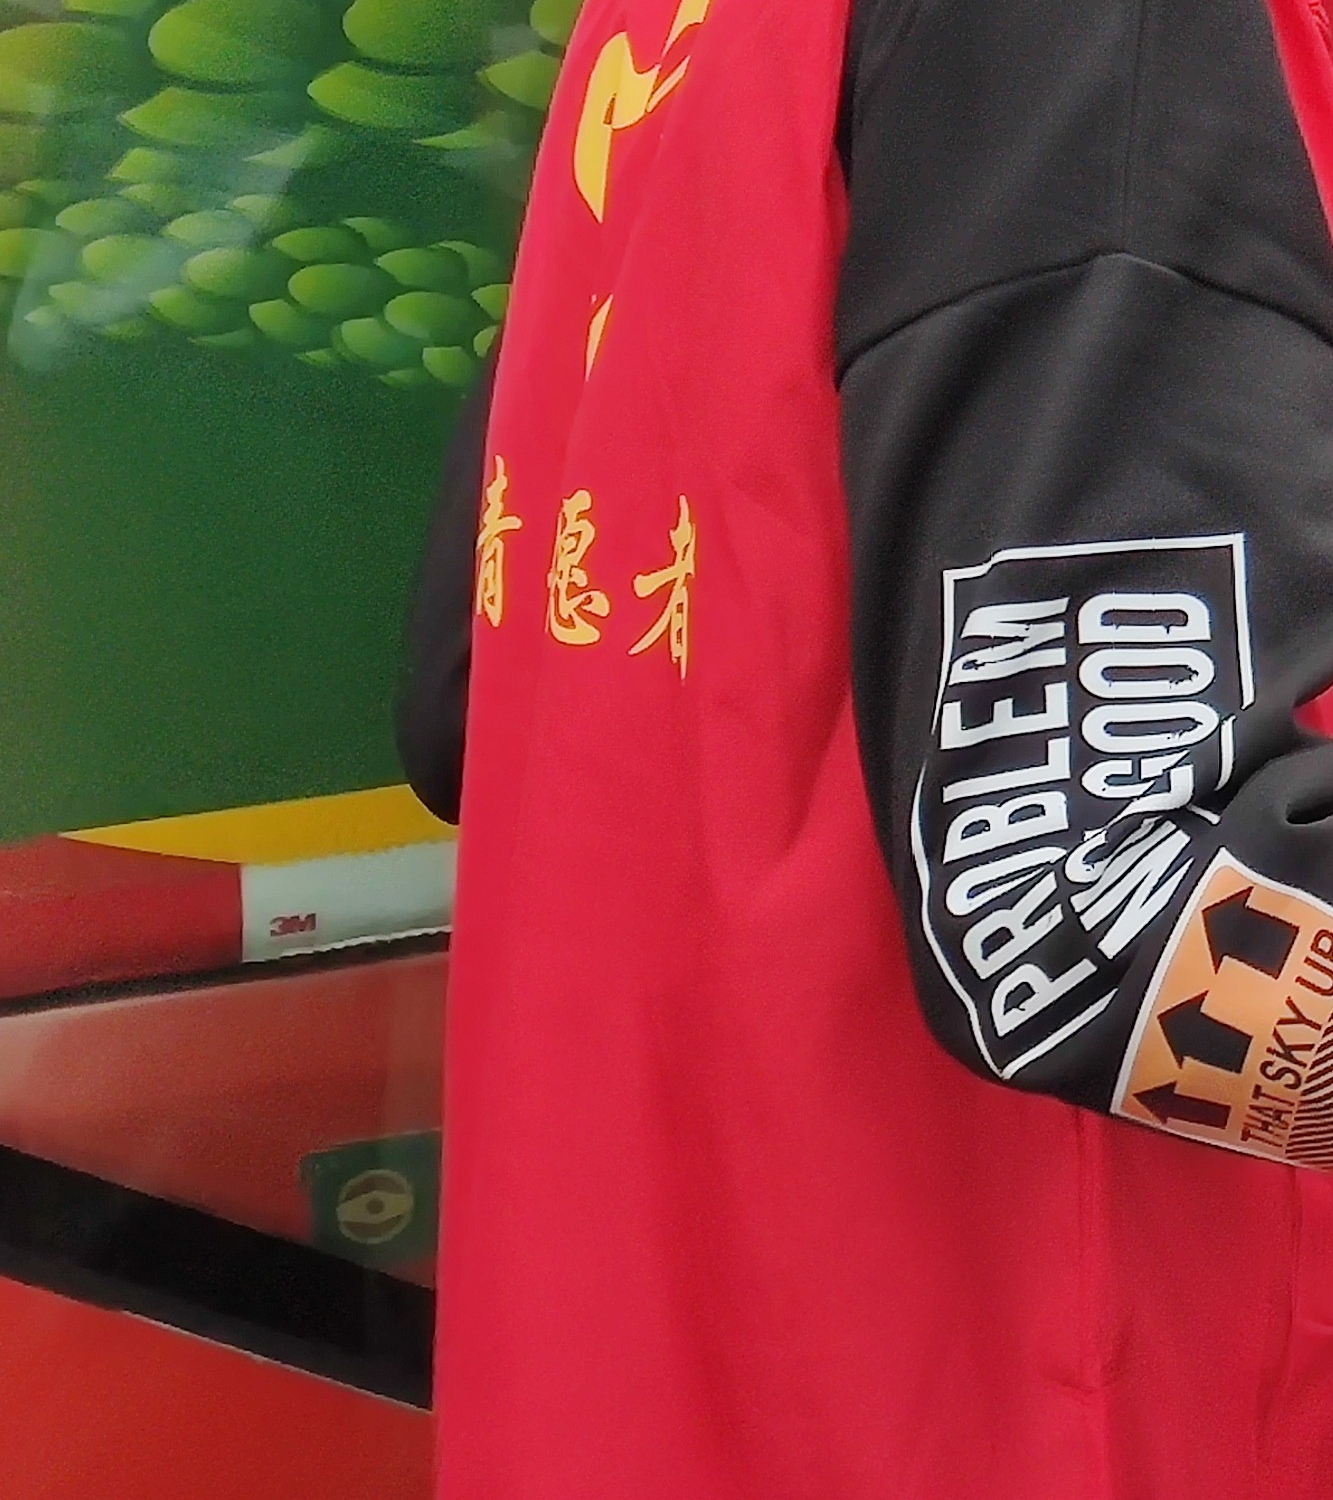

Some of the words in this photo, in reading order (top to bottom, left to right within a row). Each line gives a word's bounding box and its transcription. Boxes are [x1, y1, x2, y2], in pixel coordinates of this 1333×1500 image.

[1077, 592, 1221, 822] GOOD
[941, 596, 1098, 1037] PROBLEM
[269, 912, 317, 937] 3M
[1259, 995, 1323, 1090] SKY
[1240, 1083, 1296, 1148] THAT
